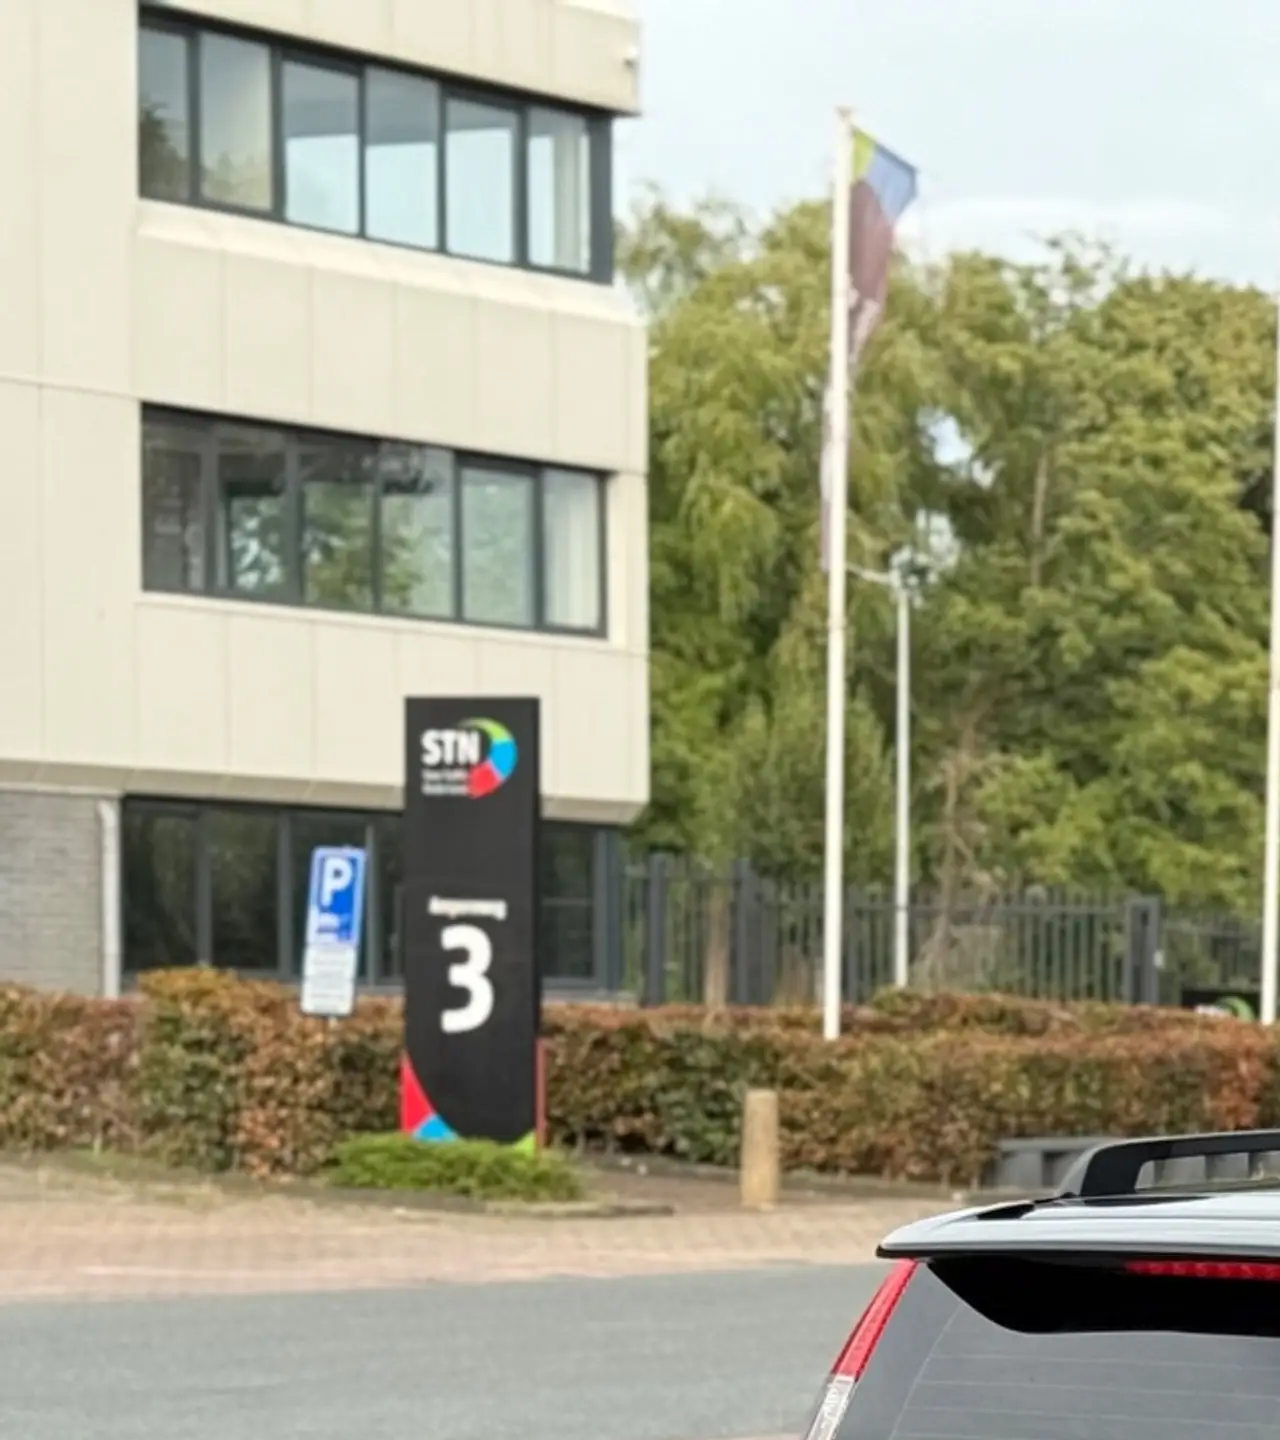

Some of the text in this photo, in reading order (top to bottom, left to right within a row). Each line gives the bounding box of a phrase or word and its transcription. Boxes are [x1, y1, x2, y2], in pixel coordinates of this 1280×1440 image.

[422, 728, 480, 766] STN
[321, 857, 353, 907] P
[441, 924, 494, 1034] 3
